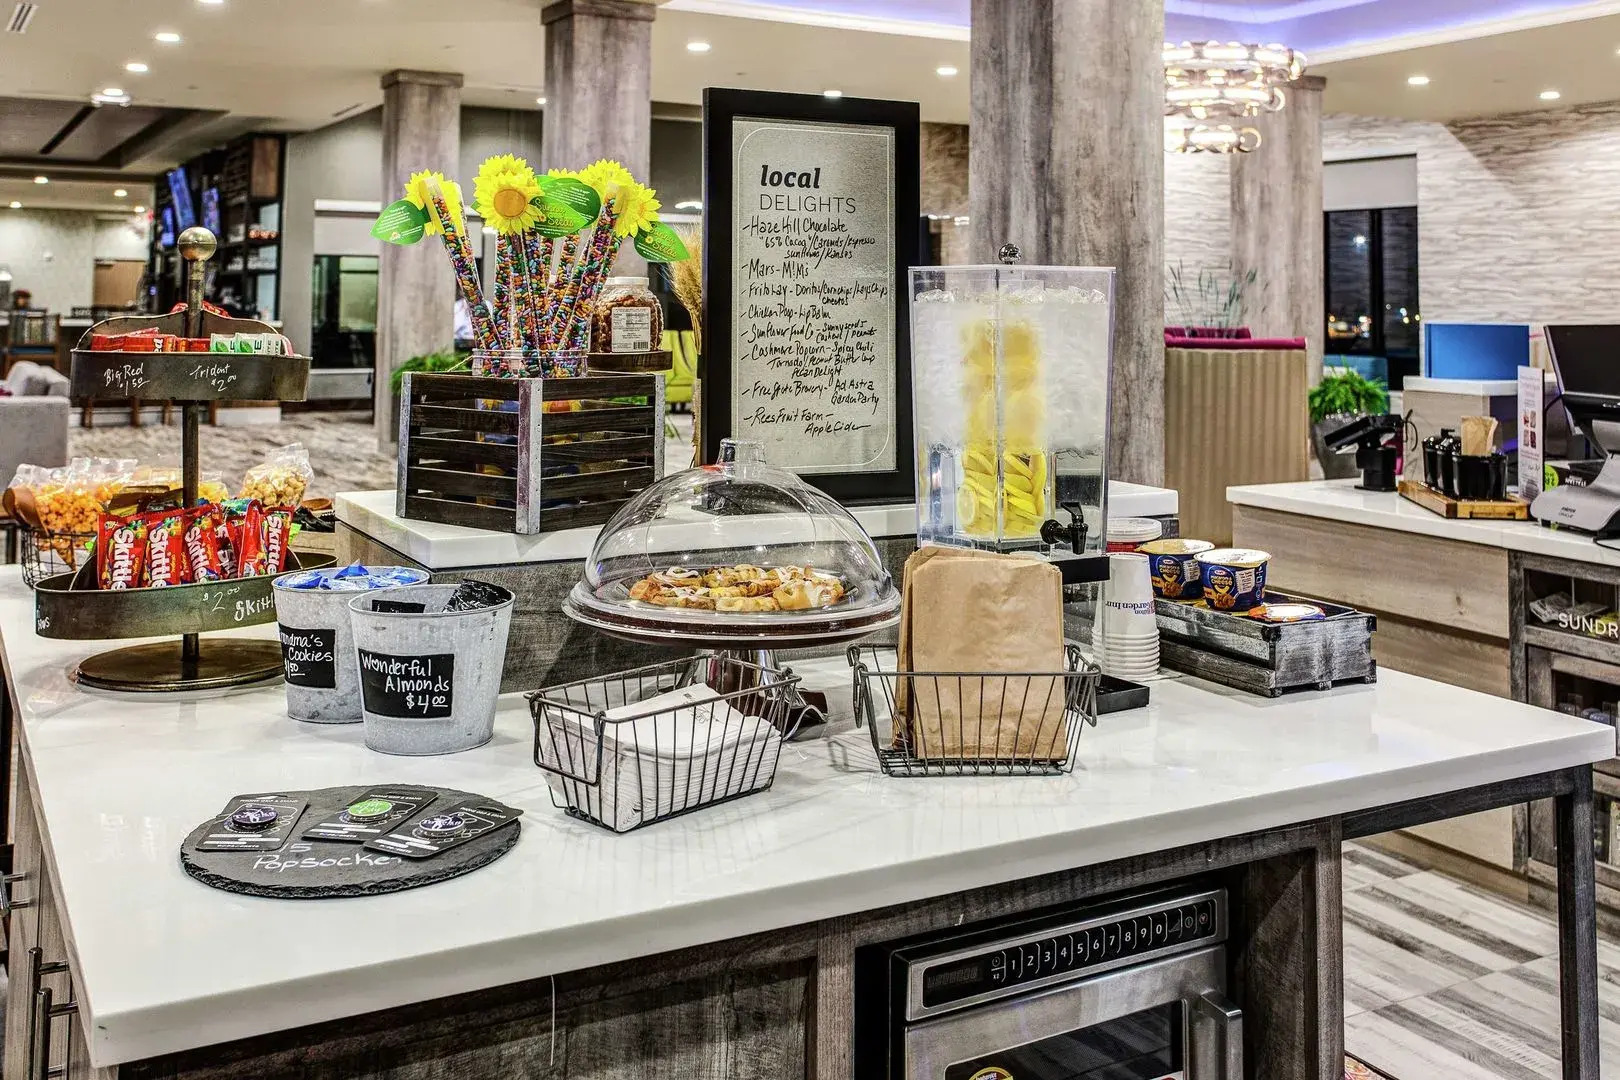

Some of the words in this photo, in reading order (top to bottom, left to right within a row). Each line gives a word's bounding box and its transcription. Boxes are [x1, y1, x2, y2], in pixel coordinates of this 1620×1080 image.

[761, 165, 820, 189] local
[760, 194, 856, 214] DELIGHTS
[803, 218, 848, 233] Chocolate
[795, 341, 825, 358] Popcorn
[123, 363, 143, 380] Red
[190, 364, 230, 379] Trident
[834, 379, 846, 391] Ad
[849, 379, 874, 391] Astra
[857, 391, 879, 414] Party
[801, 409, 823, 421] Farm
[805, 422, 832, 437] Apple
[267, 516, 283, 575] Skittle
[111, 528, 134, 590] Skittle
[150, 528, 172, 588] Skittle
[288, 647, 333, 662] Cookies
[361, 653, 432, 677] Wonderful
[385, 675, 449, 693] Almonds
[1011, 959, 1016, 971] 1
[1027, 955, 1034, 966] 2
[1044, 951, 1050, 962] 3
[1060, 947, 1068, 957] 4
[1077, 943, 1083, 954] 5
[1093, 939, 1100, 950] 6
[1109, 935, 1116, 946] 7
[1125, 931, 1131, 942] 8
[1140, 928, 1147, 939] 9
[1156, 924, 1163, 934] 0
